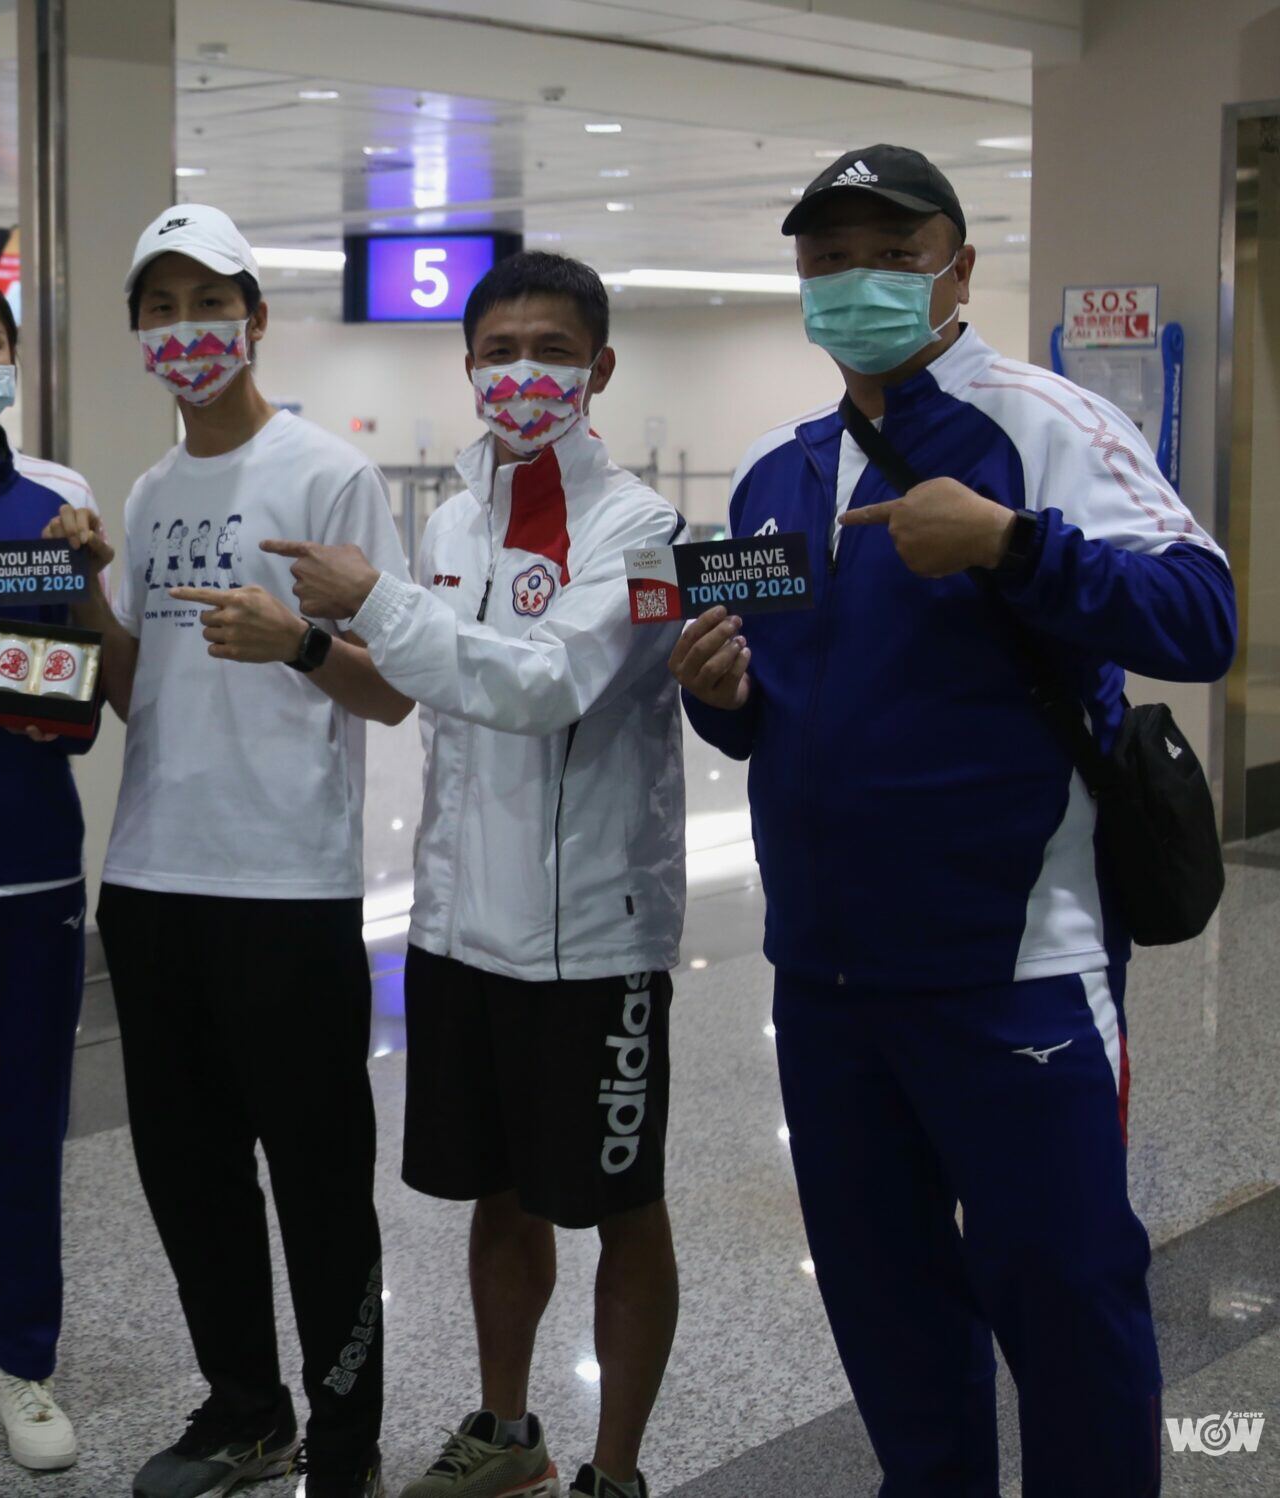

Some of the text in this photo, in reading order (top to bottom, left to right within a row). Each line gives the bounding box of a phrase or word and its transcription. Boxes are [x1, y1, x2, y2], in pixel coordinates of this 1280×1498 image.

[411, 248, 449, 308] 5
[1083, 290, 1137, 313] S.O.S
[0, 550, 69, 566] YOU HAVE
[700, 548, 786, 571] YOU HAVE
[52, 564, 72, 574] FOR
[700, 565, 790, 584] QUALIFIED FOR
[43, 575, 85, 591] 2020
[687, 577, 806, 604] TOKYO 2020
[188, 609, 197, 617] TO
